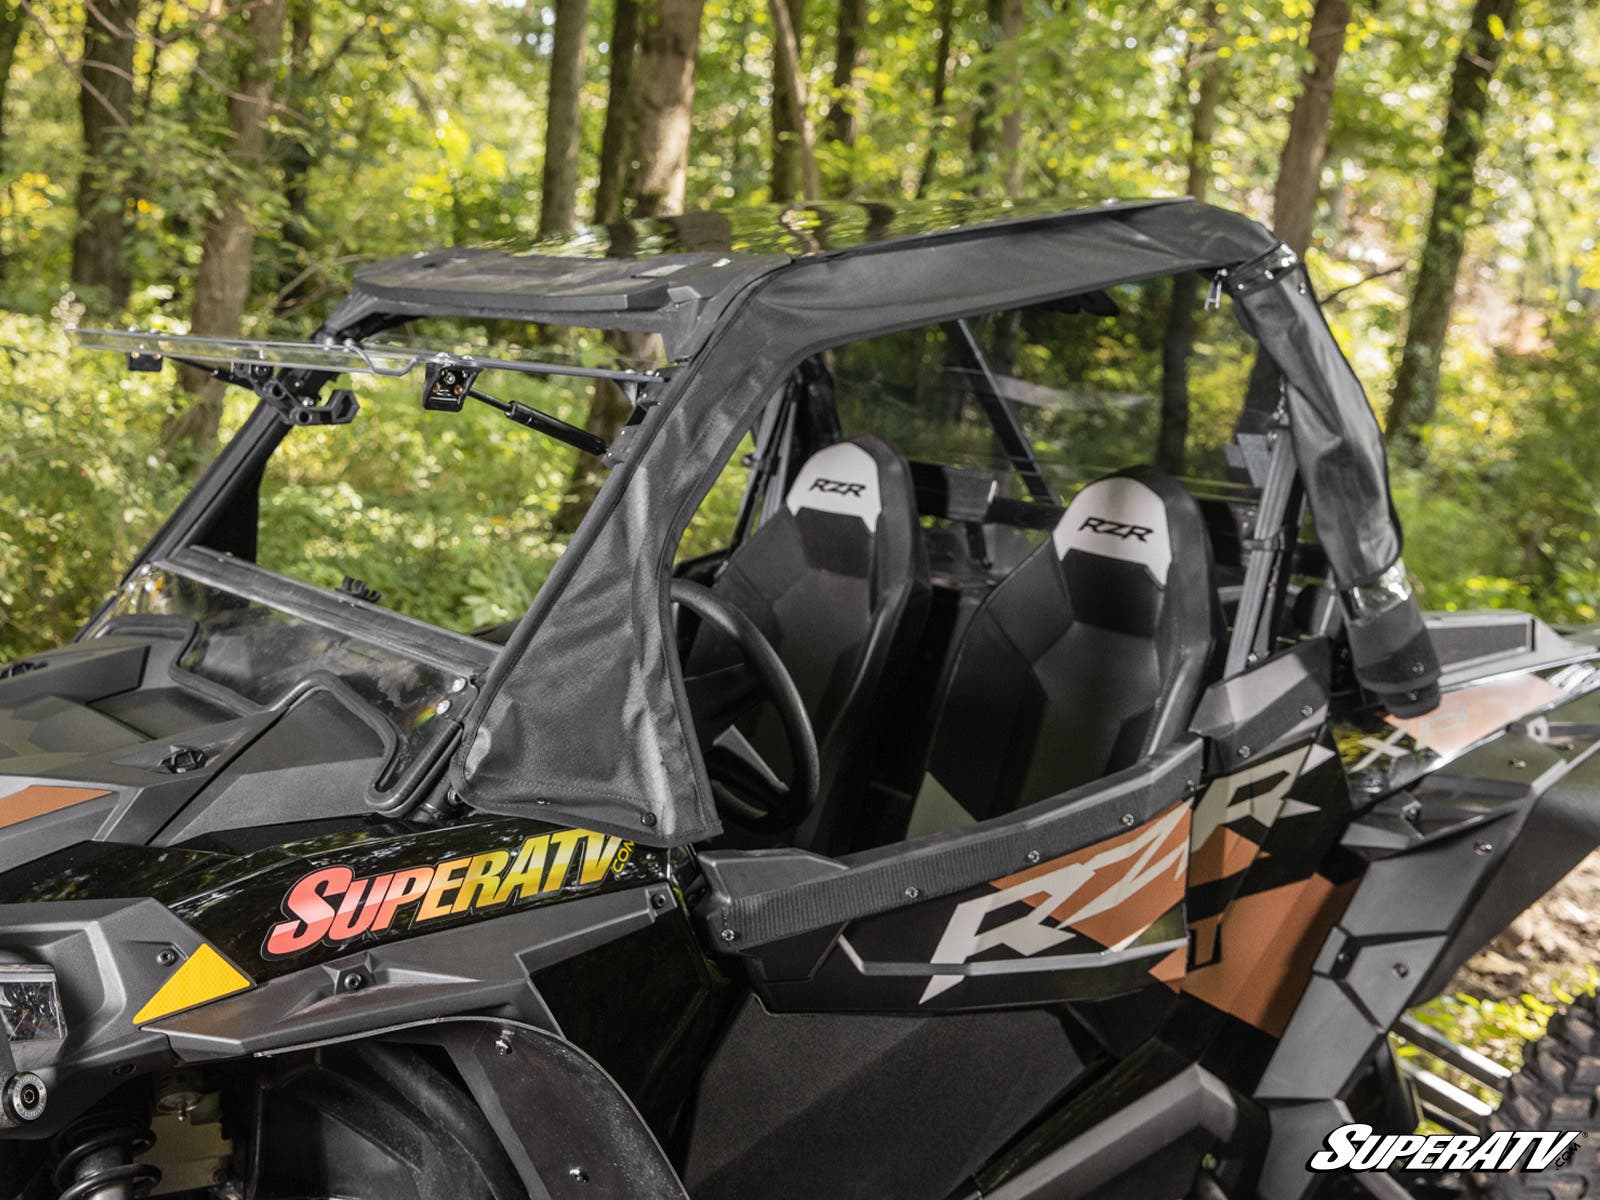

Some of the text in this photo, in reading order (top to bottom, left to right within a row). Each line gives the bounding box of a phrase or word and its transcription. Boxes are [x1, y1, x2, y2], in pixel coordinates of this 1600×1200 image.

[809, 477, 867, 498] RZR
[1079, 516, 1154, 543] RZR
[267, 829, 623, 956] SUPERATV
[918, 744, 1335, 1004] RZR
